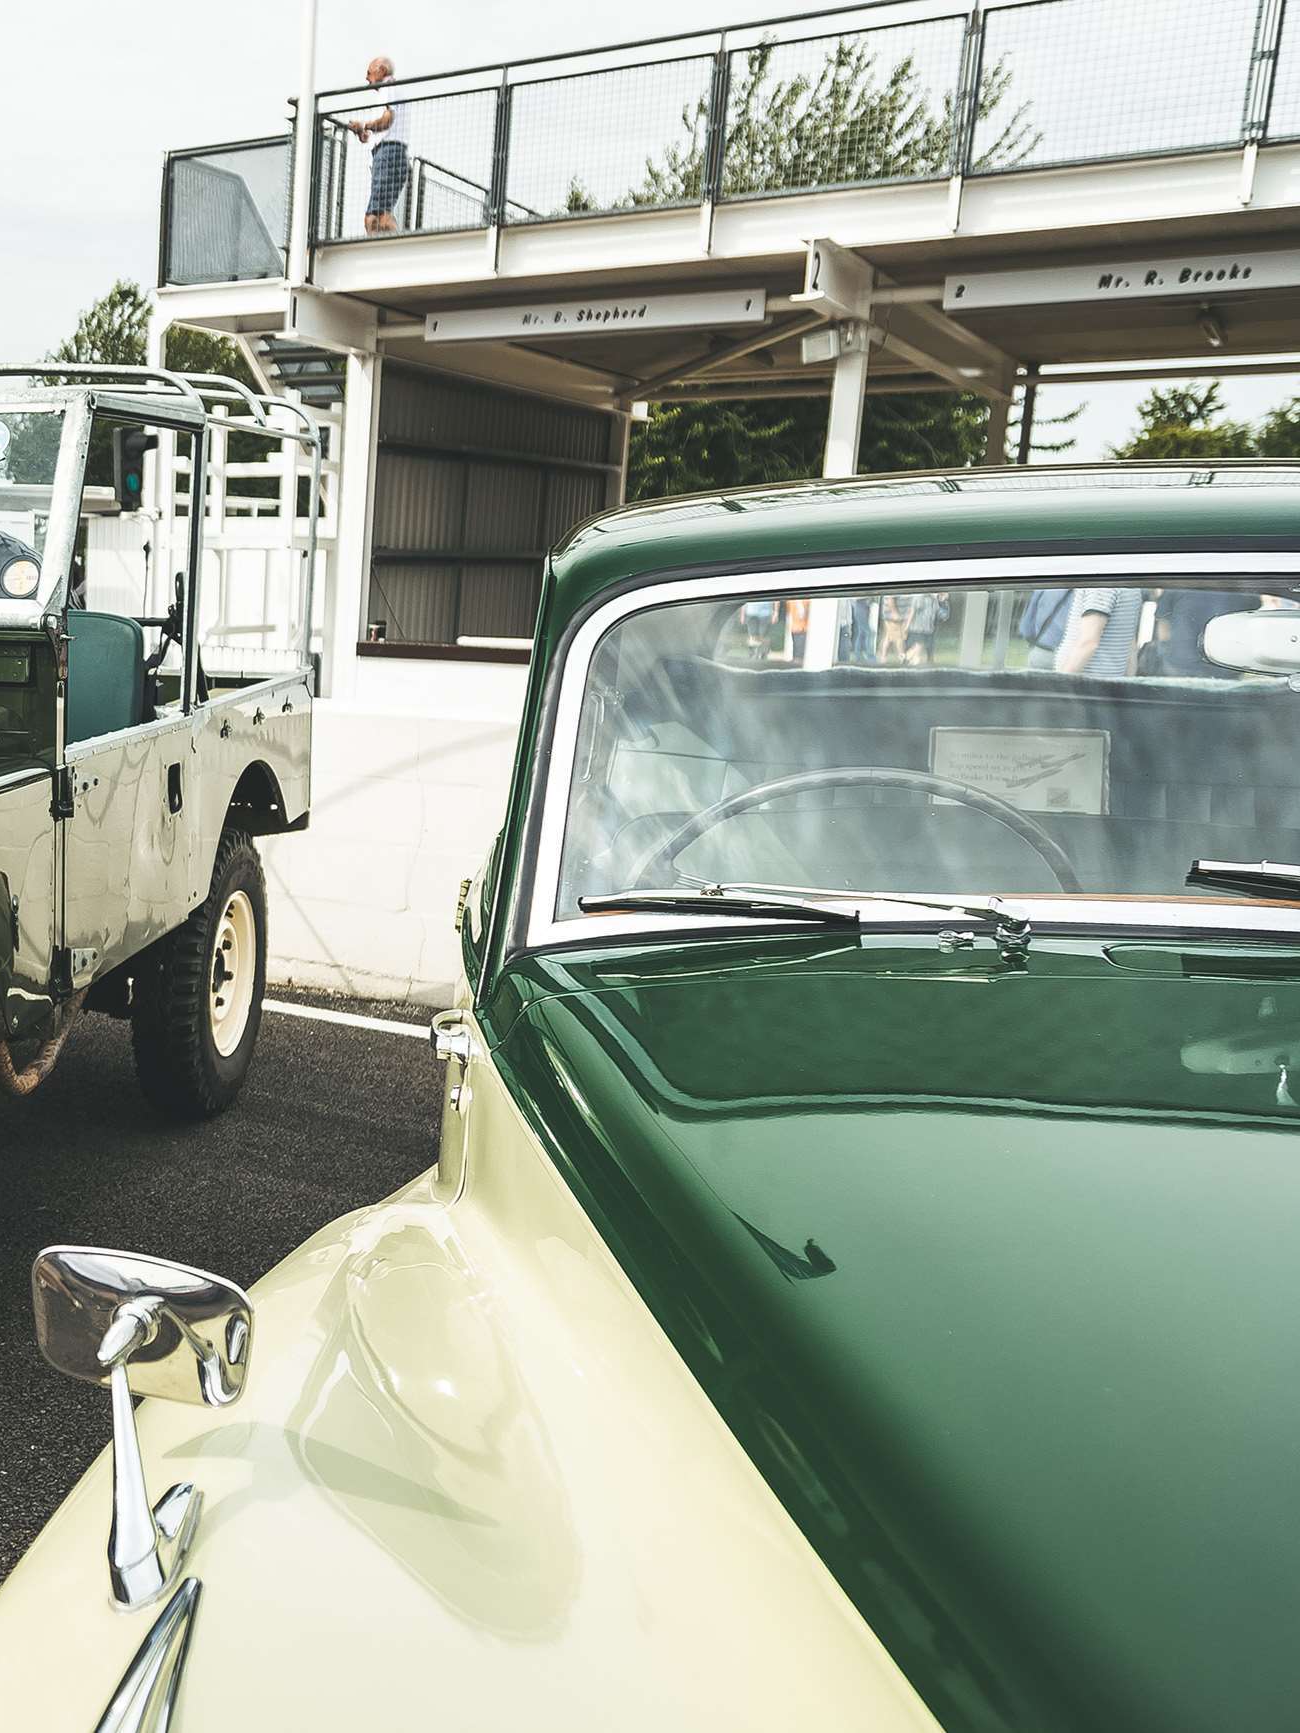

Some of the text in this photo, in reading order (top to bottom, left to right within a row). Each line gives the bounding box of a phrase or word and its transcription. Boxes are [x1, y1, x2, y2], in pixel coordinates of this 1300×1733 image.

[1098, 272, 1130, 289] Mr.
[1144, 269, 1164, 287] R.
[955, 284, 966, 298] 2
[521, 312, 544, 325] Mr.
[577, 304, 647, 323] Shepherd
